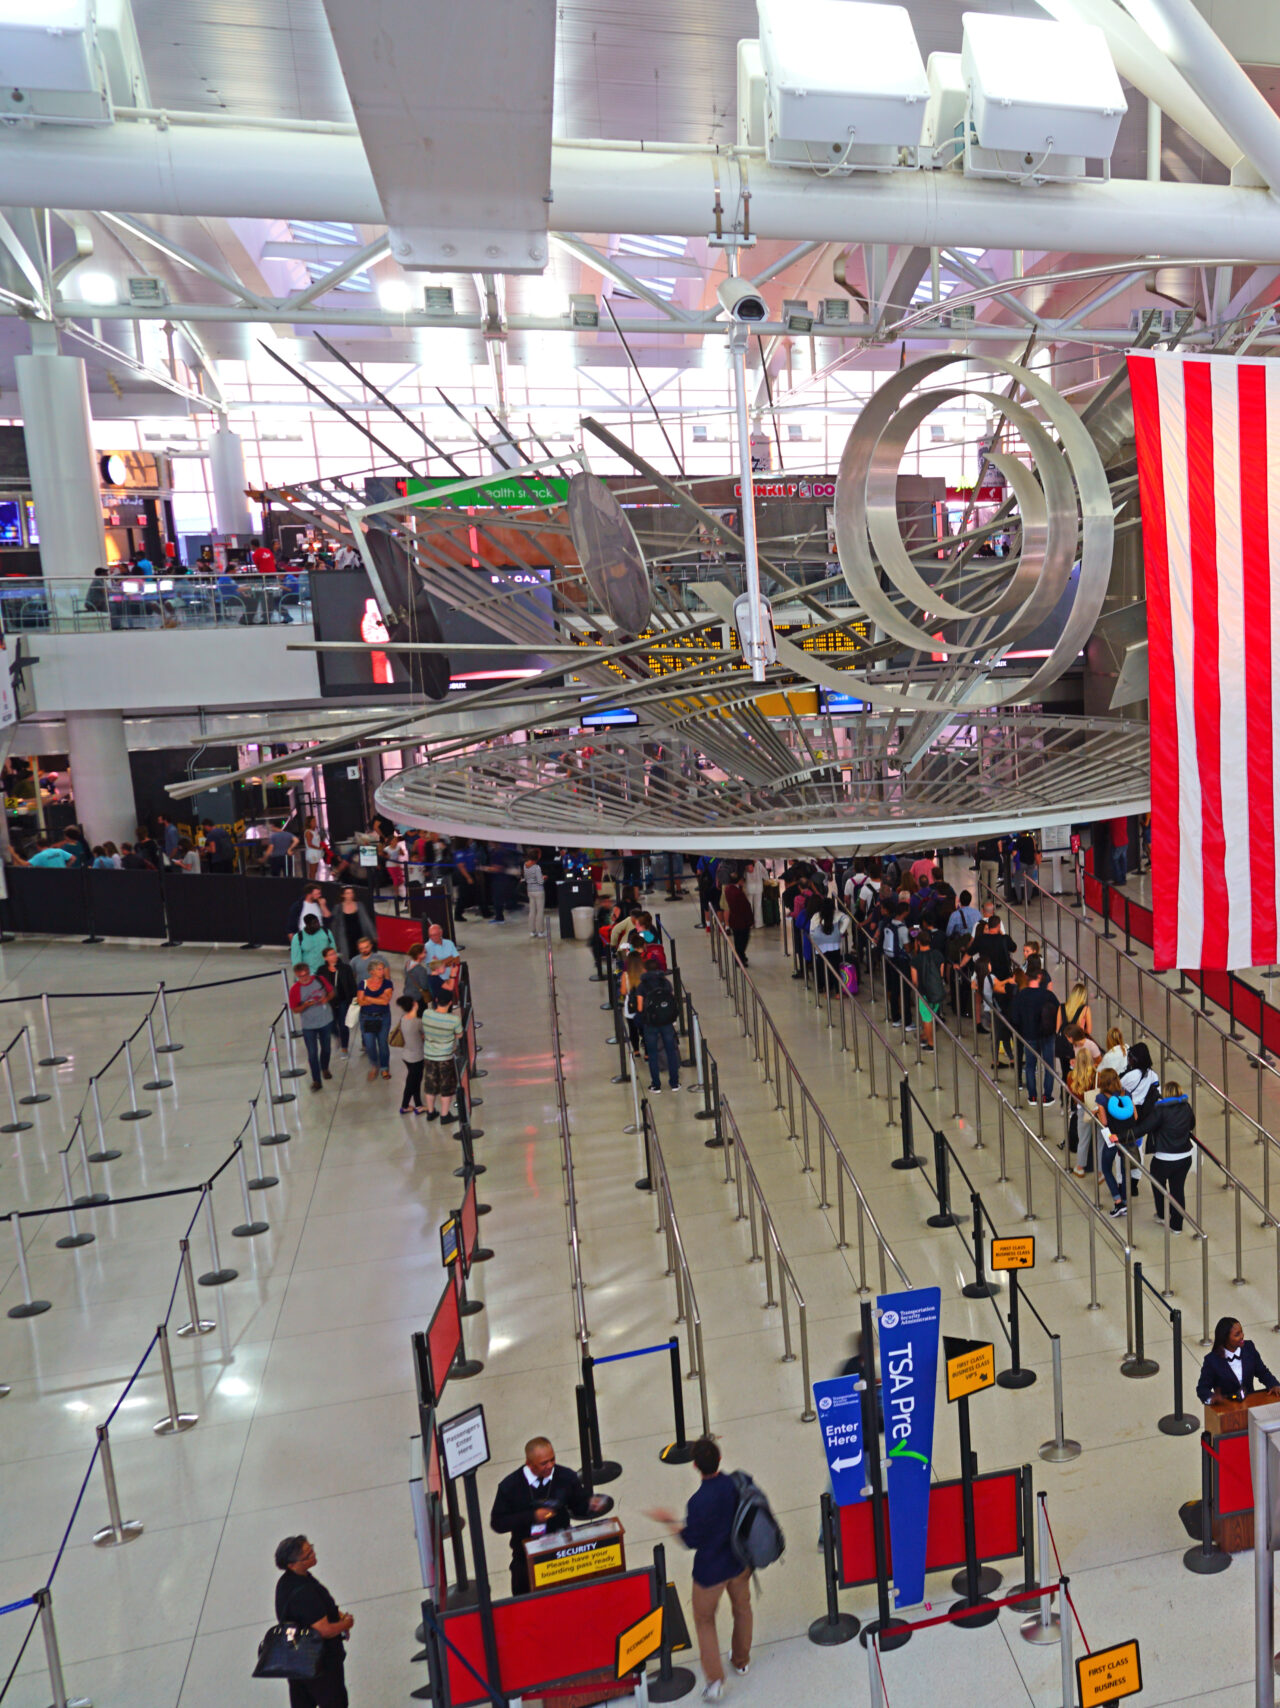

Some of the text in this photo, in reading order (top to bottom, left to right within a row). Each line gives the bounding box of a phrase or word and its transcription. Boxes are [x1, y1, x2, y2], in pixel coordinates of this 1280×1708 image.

[734, 482, 798, 498] DNKIN'
[900, 1306, 936, 1316] Transportation
[900, 1316, 936, 1326] Administration
[970, 1354, 984, 1364] CLASS
[952, 1360, 990, 1378] BUSINESS CLASS
[888, 1342, 915, 1440] TSA Pre
[446, 1423, 480, 1444] Passengers
[826, 1422, 859, 1436] Enter
[456, 1436, 472, 1448] Enter
[828, 1434, 858, 1448] Here
[458, 1444, 473, 1456] Here
[556, 1542, 597, 1559] SECURITY
[541, 1555, 614, 1578] boarding pass ready
[546, 1550, 608, 1569] Please have your
[626, 1630, 654, 1656] ECONOMY
[1088, 1657, 1128, 1678] FIRST CLASS
[1094, 1676, 1126, 1694] BUSINESS
